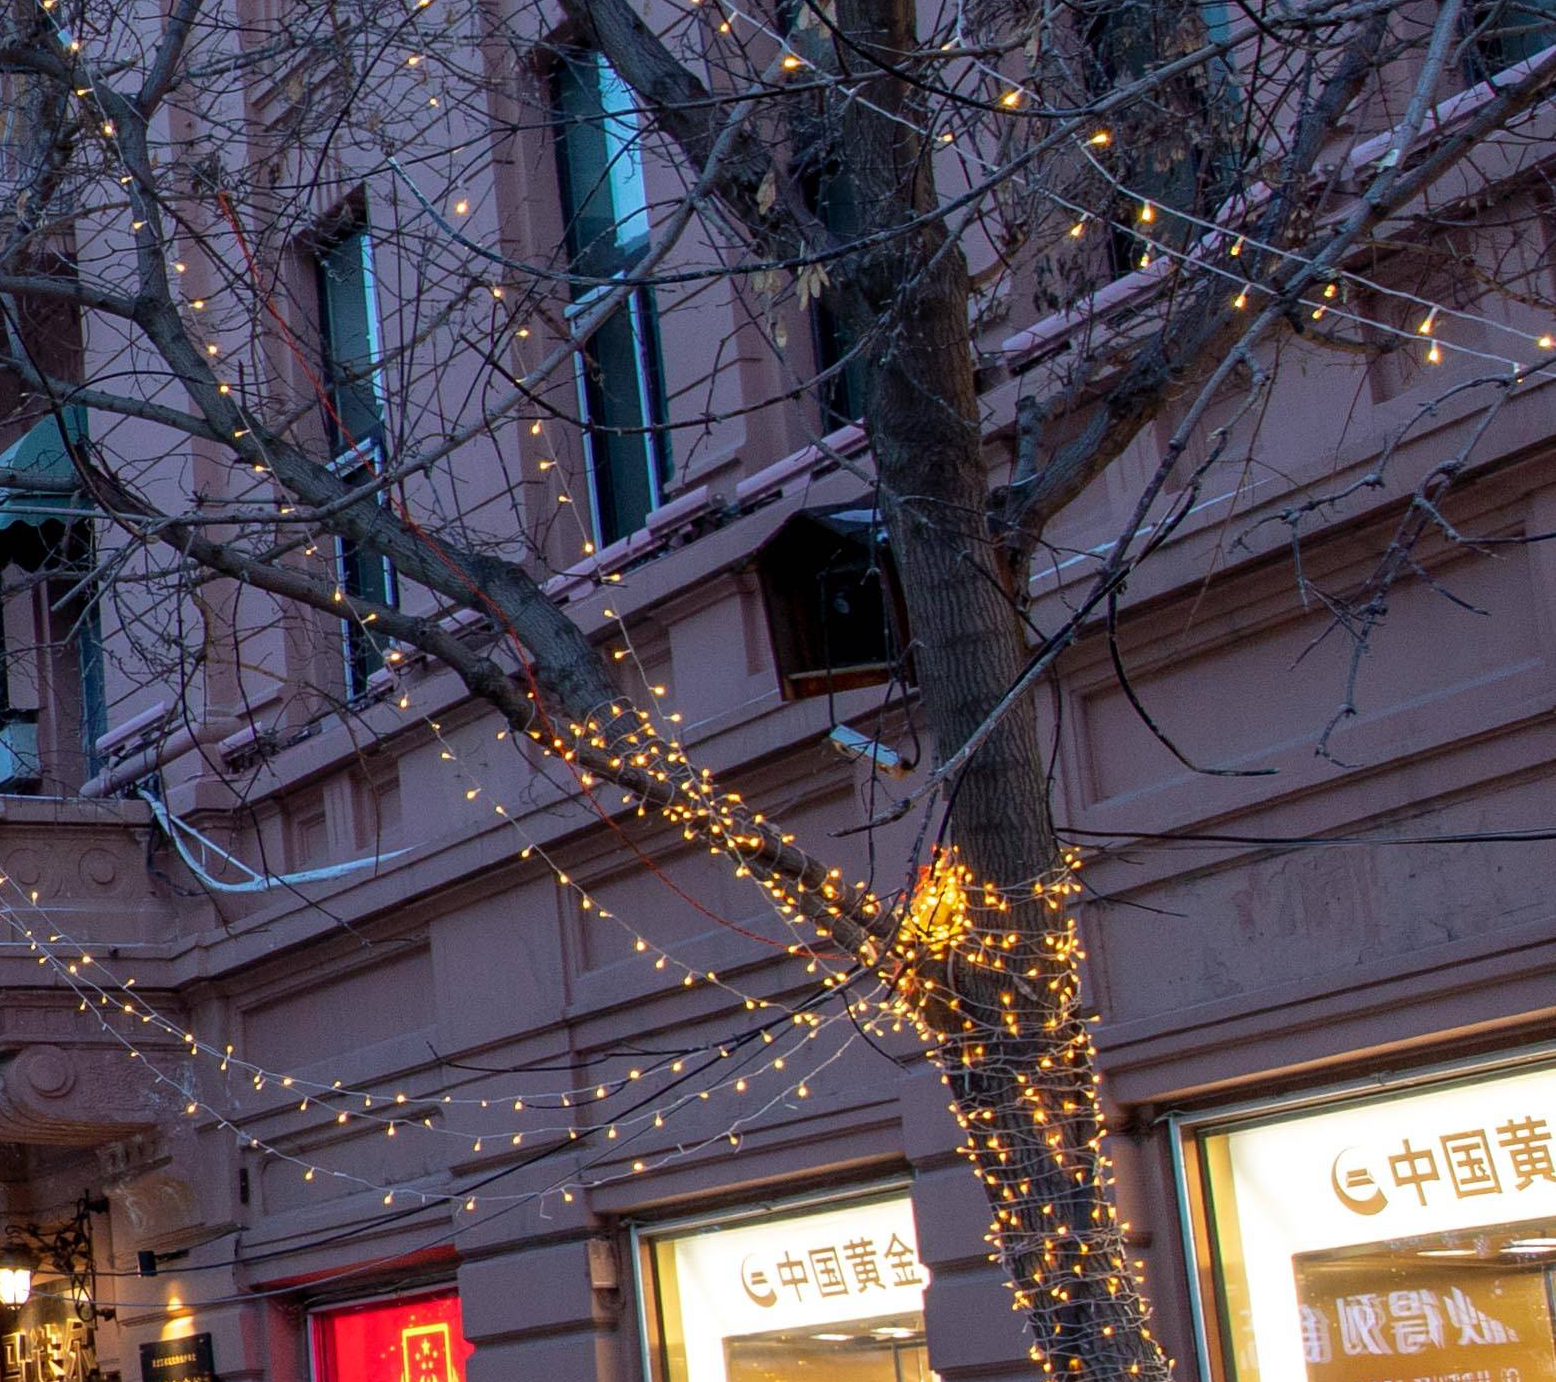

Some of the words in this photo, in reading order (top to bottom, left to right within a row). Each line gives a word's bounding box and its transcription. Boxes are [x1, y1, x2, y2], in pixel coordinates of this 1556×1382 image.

[1387, 1115, 1556, 1207] 中国黄
[776, 1232, 923, 1303] 中国黄金
